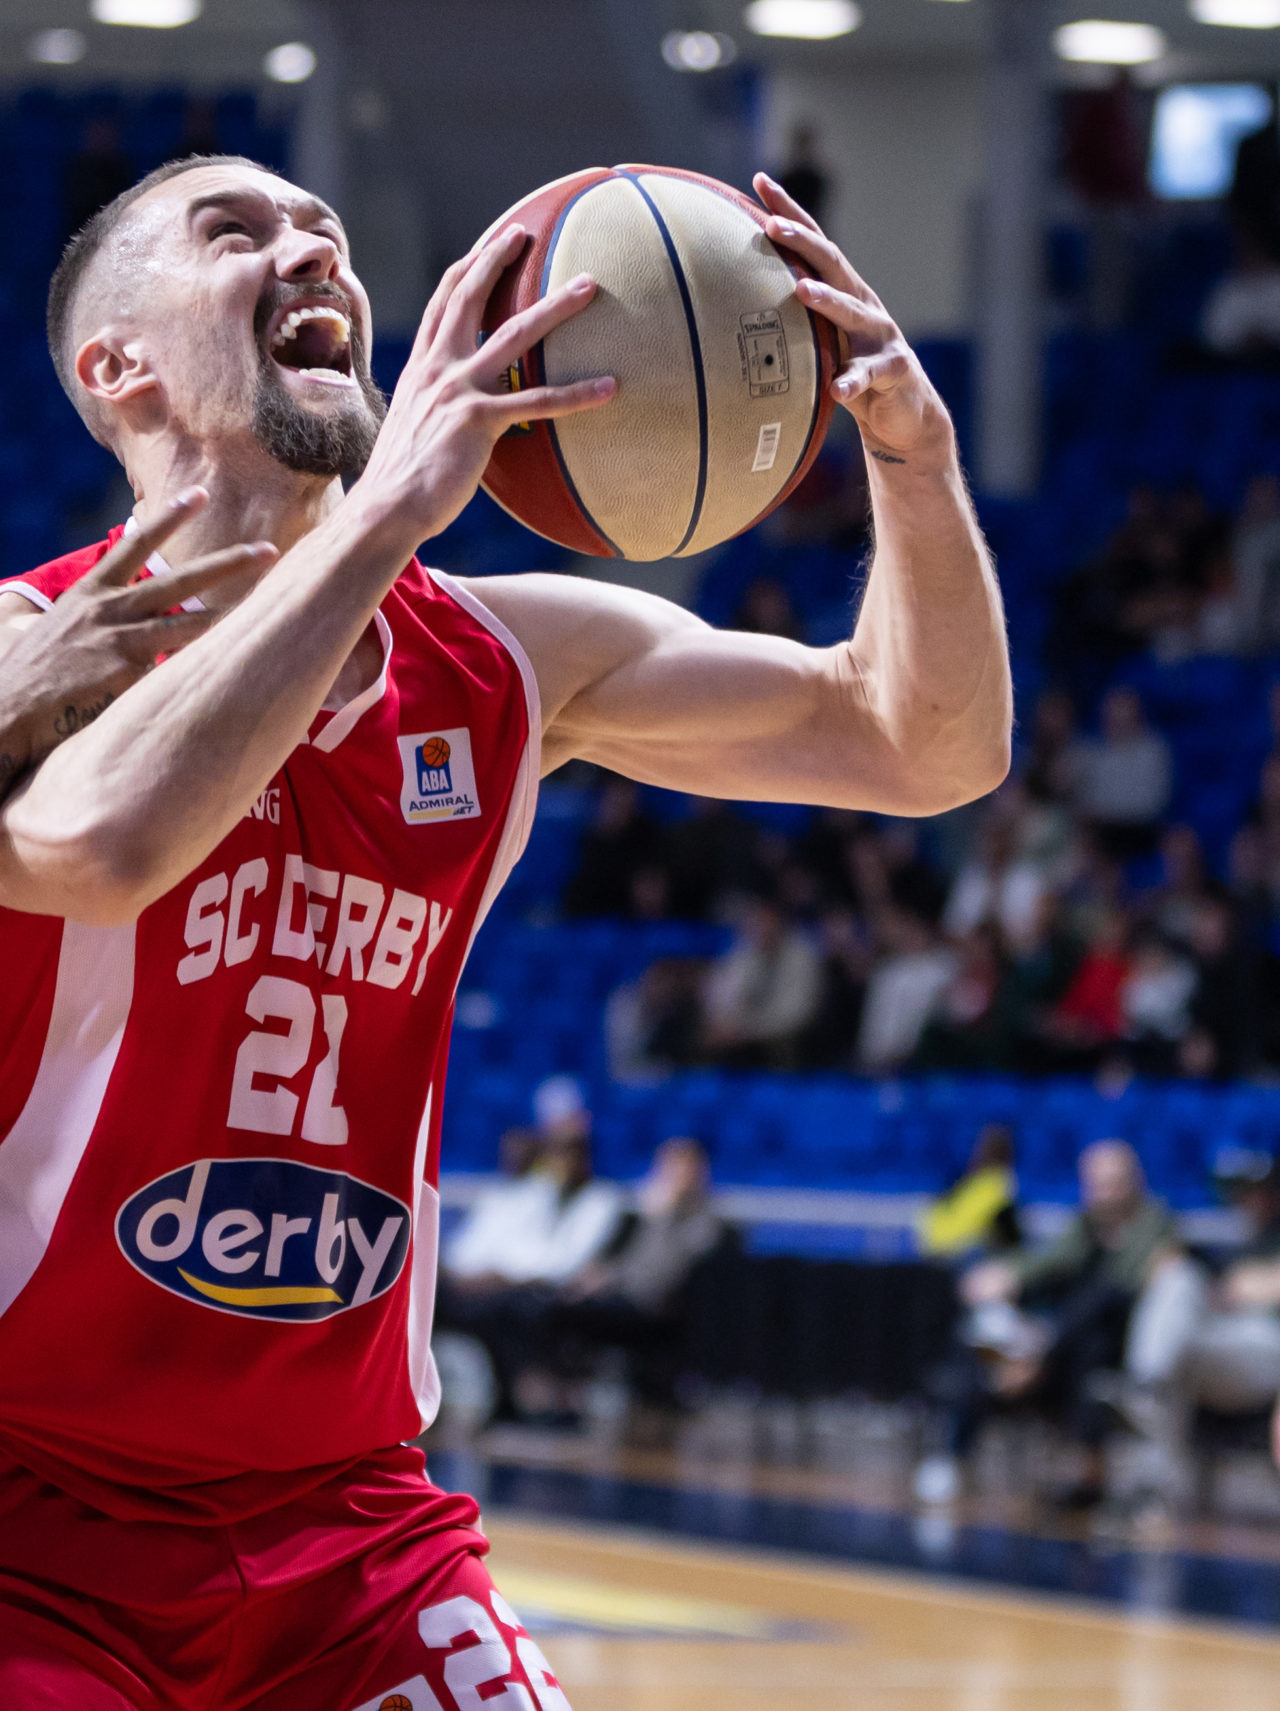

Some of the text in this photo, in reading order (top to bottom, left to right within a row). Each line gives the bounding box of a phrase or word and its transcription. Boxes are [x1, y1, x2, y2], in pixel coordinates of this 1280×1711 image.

[409, 794, 474, 812] ADMIRAL
[422, 768, 450, 793] ABA
[176, 853, 453, 997] SC DERBY
[135, 1160, 404, 1305] derby
